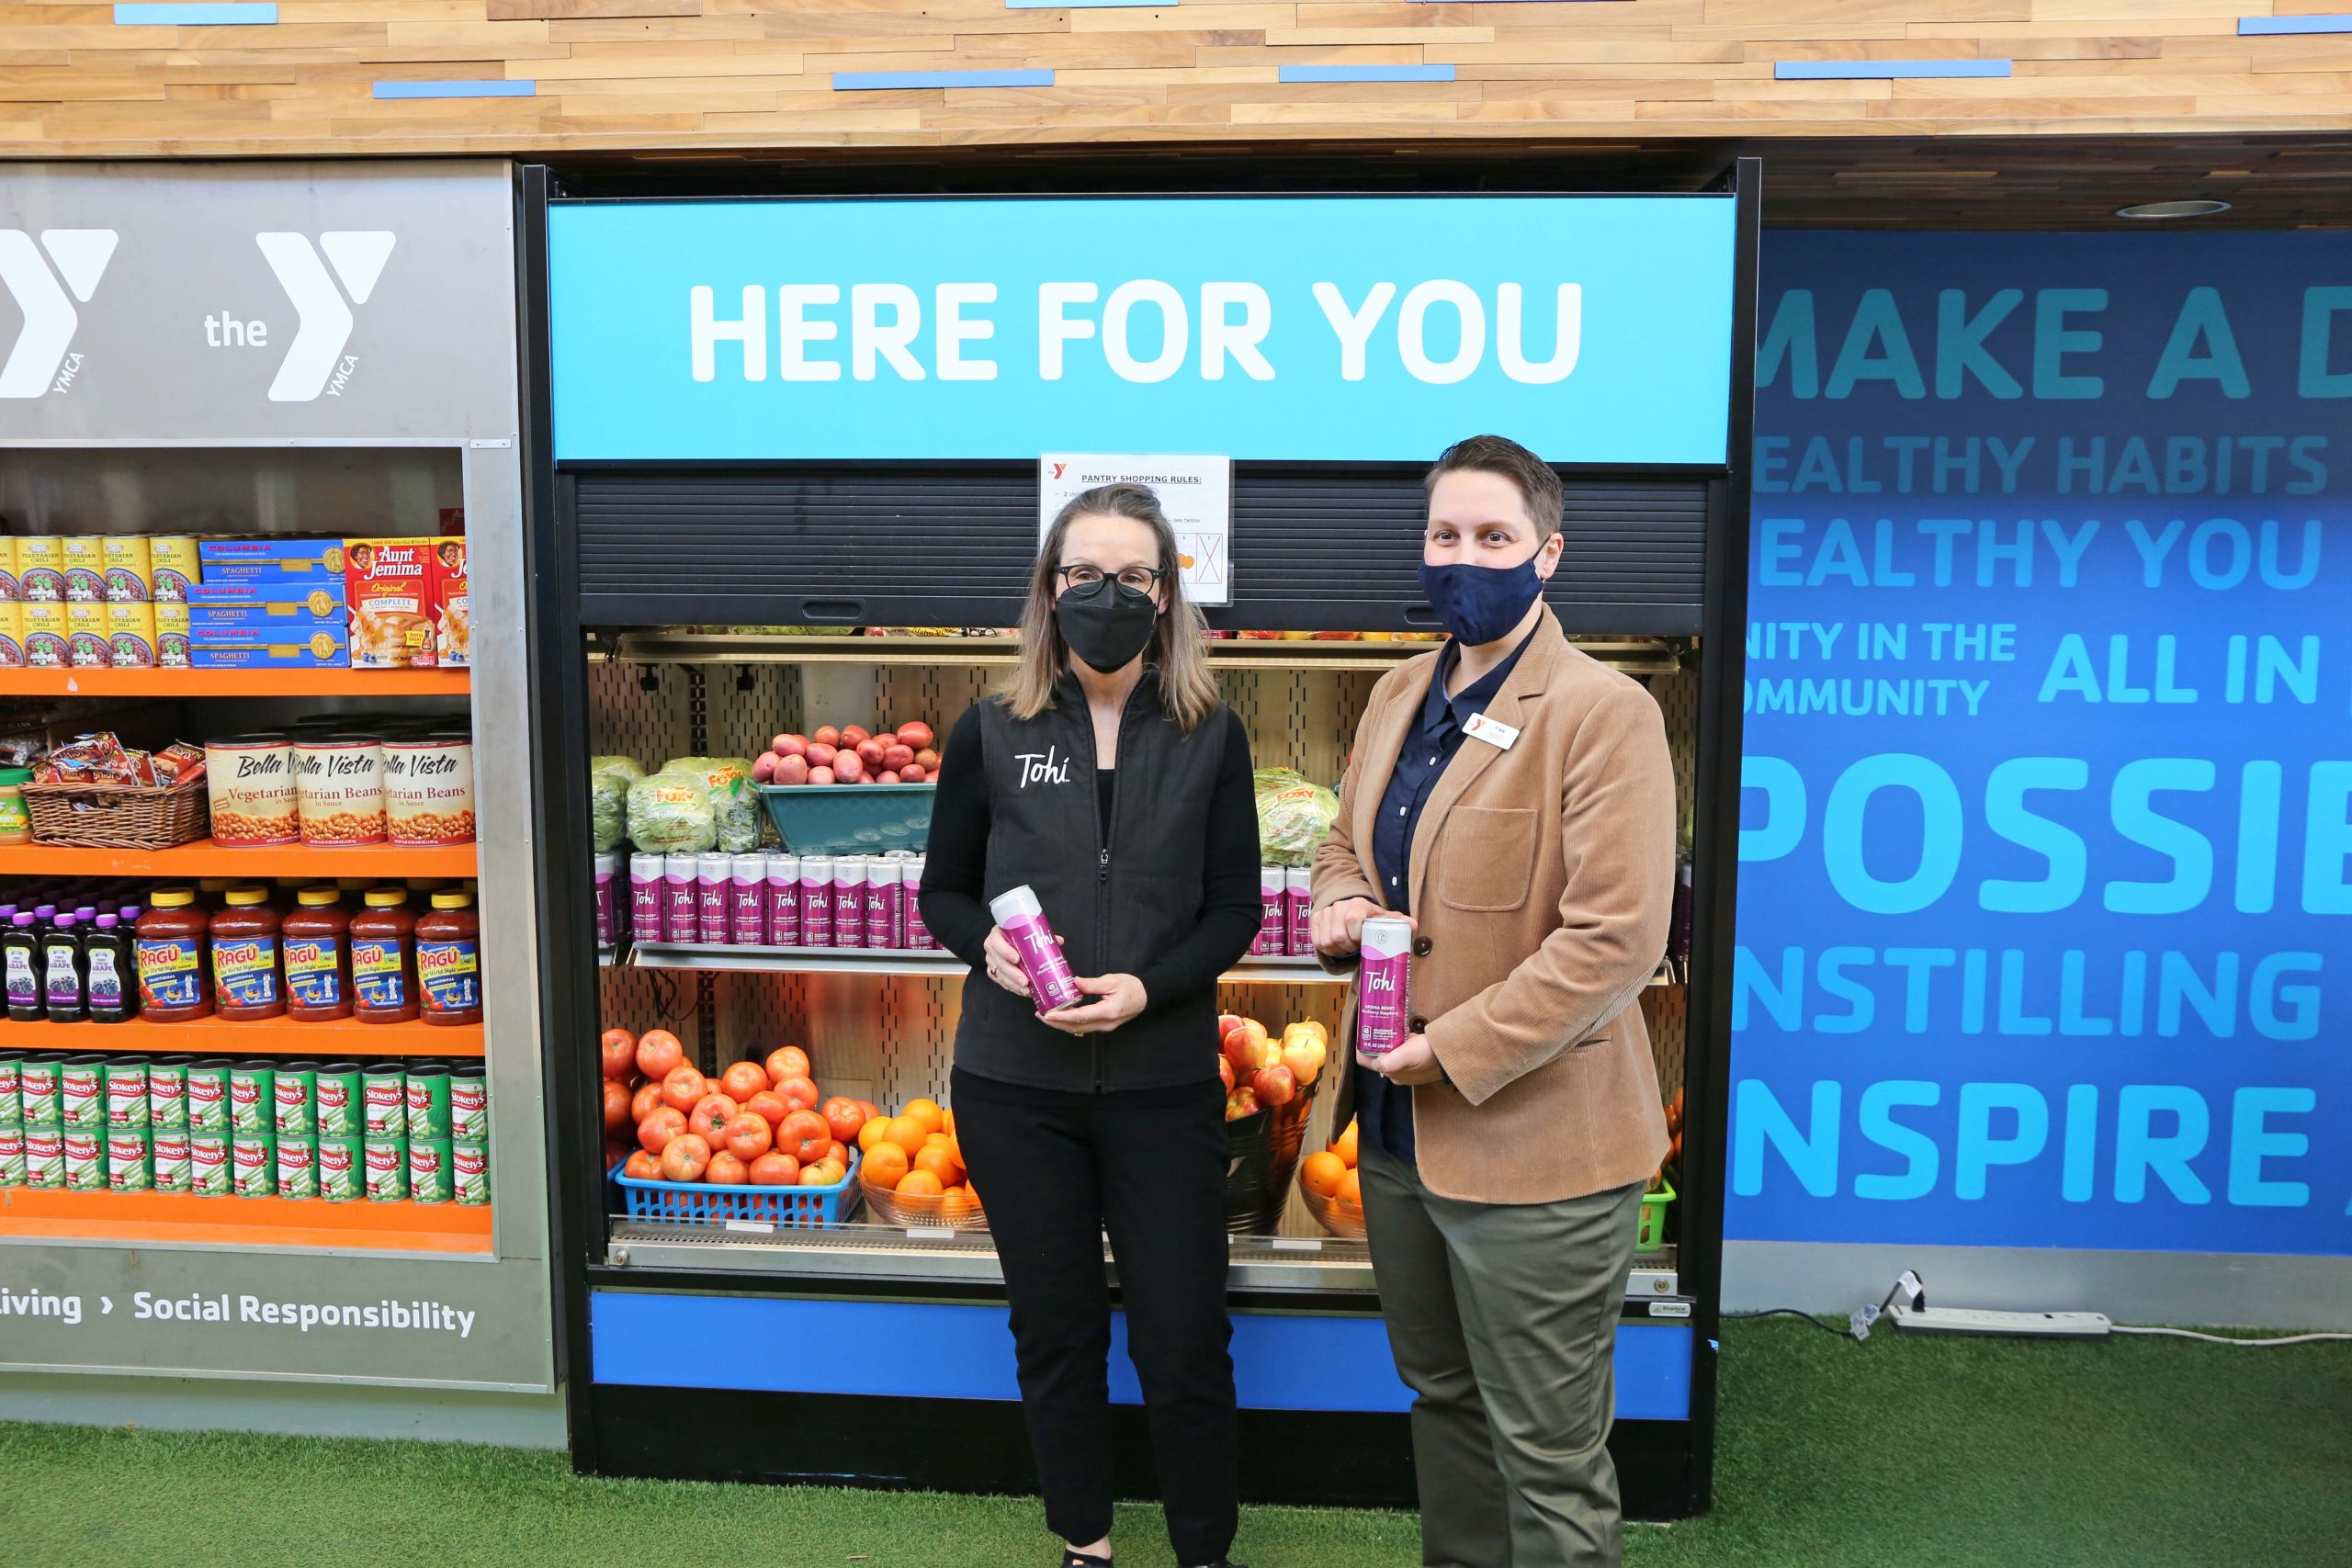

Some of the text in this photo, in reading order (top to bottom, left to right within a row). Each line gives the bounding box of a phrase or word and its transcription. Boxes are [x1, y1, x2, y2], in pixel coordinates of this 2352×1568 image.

[204, 310, 267, 346] the
[690, 279, 1582, 384] HERE FOR YOU
[1755, 288, 2109, 400] MAKE
[2145, 286, 2251, 400] A
[52, 351, 85, 395] YMCA
[326, 354, 358, 398] YMCA
[1752, 435, 2329, 494] EALTHY HABITS
[1081, 474, 1117, 482] PANTRY
[1120, 475, 1168, 483] SHOPPING
[379, 546, 415, 562] Aunt
[1759, 518, 2323, 590] EALTHY YOU
[363, 560, 423, 581] Jemima
[371, 581, 407, 597] Original
[368, 598, 412, 606] COMPLETE
[1746, 622, 2017, 661] NITY IN THE
[2037, 633, 2321, 704] ALL IN
[237, 753, 283, 778] Bella
[327, 753, 377, 778] Vista
[410, 753, 458, 778] Vista
[1014, 745, 1069, 788] Tohi
[228, 785, 298, 803] Vegetarian
[345, 786, 382, 799] Beans
[426, 785, 466, 799] Beans
[634, 888, 655, 907] Tohi
[672, 888, 694, 908] Tohi
[702, 889, 723, 908] Tohi
[736, 890, 759, 909] Tohi
[775, 890, 797, 910] Tohi
[806, 891, 828, 910] Tohi
[836, 892, 858, 911] Tohi
[867, 894, 885, 910] Tohi
[1263, 899, 1283, 919] Tohi
[1295, 899, 1311, 919] Toh
[1023, 925, 1056, 954] Tohi
[1365, 967, 1396, 994] Tohi
[1731, 945, 2324, 1041] NSTILLING
[108, 1078, 146, 1093] Stokely's
[367, 1088, 402, 1101] Stokely's
[26, 1140, 62, 1153] Stokely's
[154, 1143, 190, 1155] Stokely's
[1733, 1078, 2316, 1207] NSPIRE
[133, 1292, 476, 1338] Social Responsibility
